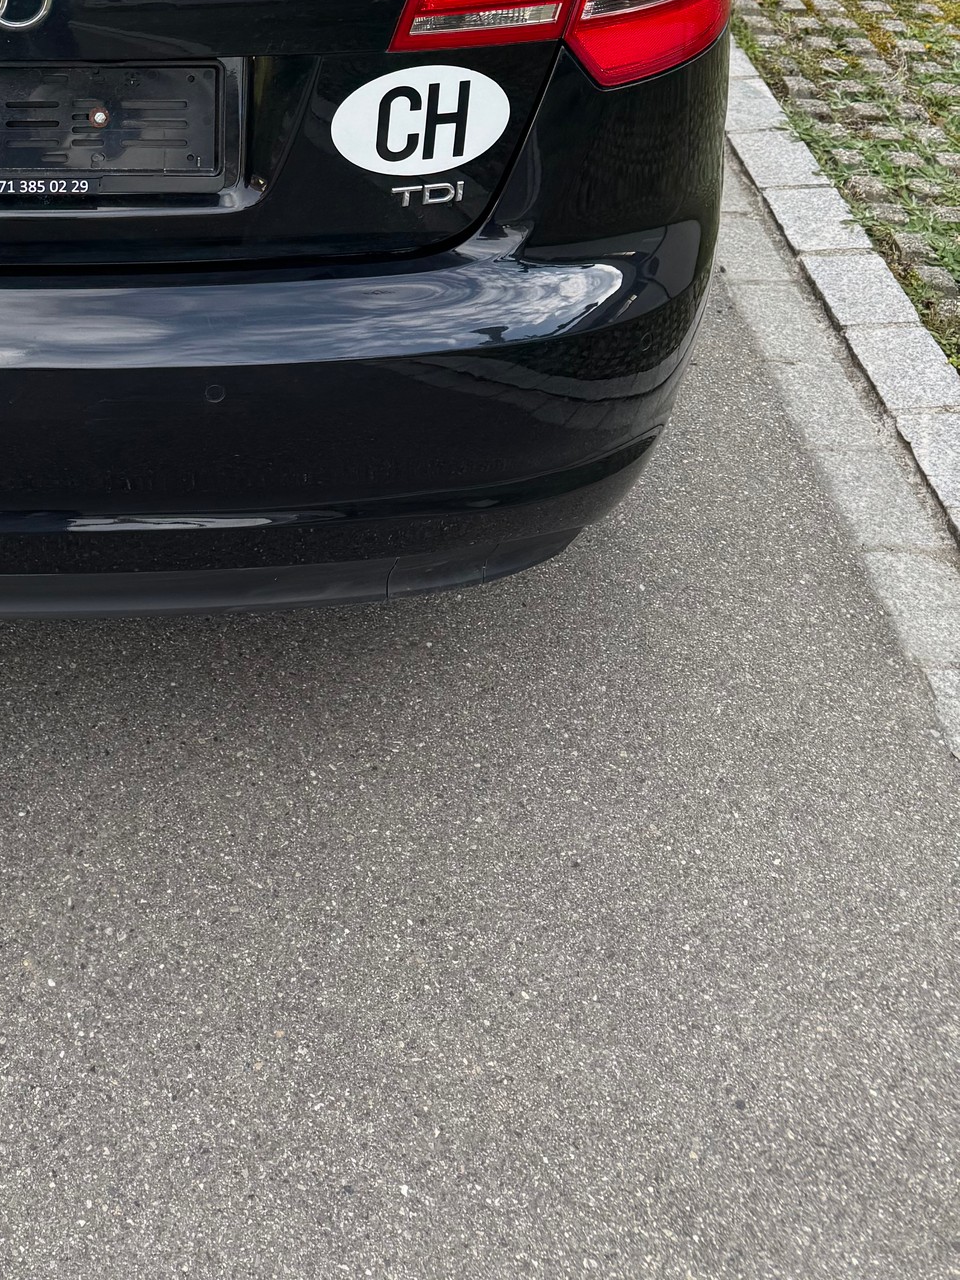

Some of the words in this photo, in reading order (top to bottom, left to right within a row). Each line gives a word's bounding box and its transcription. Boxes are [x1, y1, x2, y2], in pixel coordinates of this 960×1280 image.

[375, 80, 471, 162] CH
[19, 180, 46, 194] 385
[49, 180, 67, 193] 02
[71, 180, 89, 193] 29
[391, 181, 465, 208] TDI
